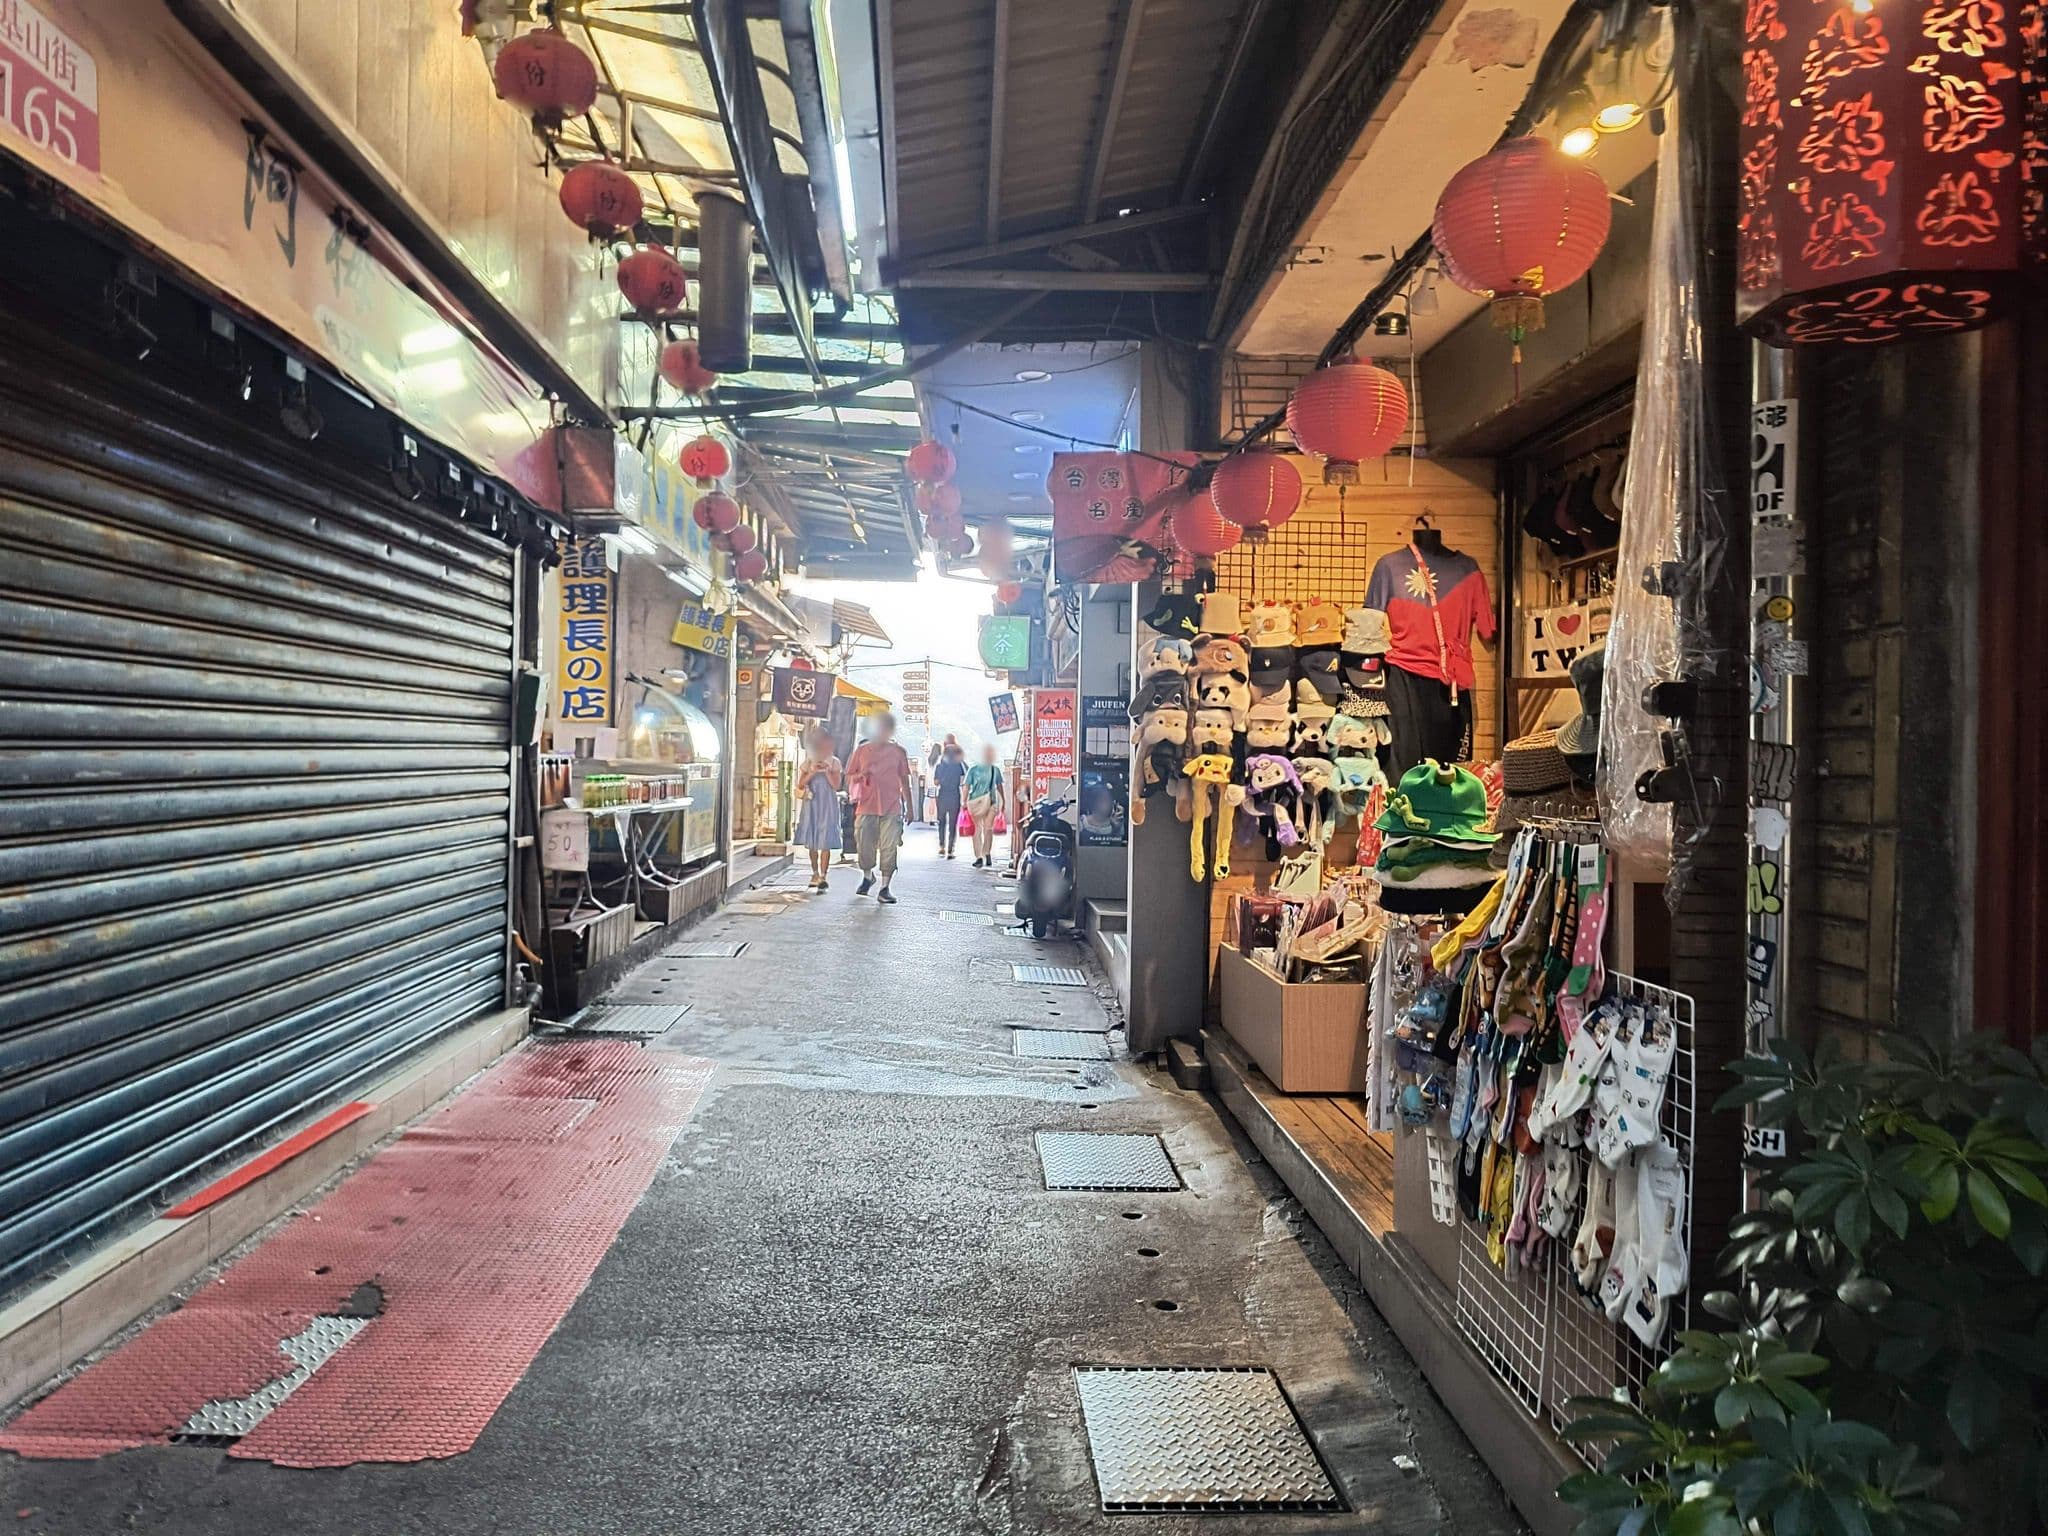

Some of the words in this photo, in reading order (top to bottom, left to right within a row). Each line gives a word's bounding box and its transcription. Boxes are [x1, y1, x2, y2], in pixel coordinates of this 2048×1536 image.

[0, 59, 78, 166] 165
[562, 537, 608, 719] 護理長の店
[1533, 616, 1545, 639] I
[702, 635, 729, 657] の店
[991, 633, 1014, 655] 茶
[1091, 700, 1126, 709] JIUFEN
[547, 834, 572, 851] 50
